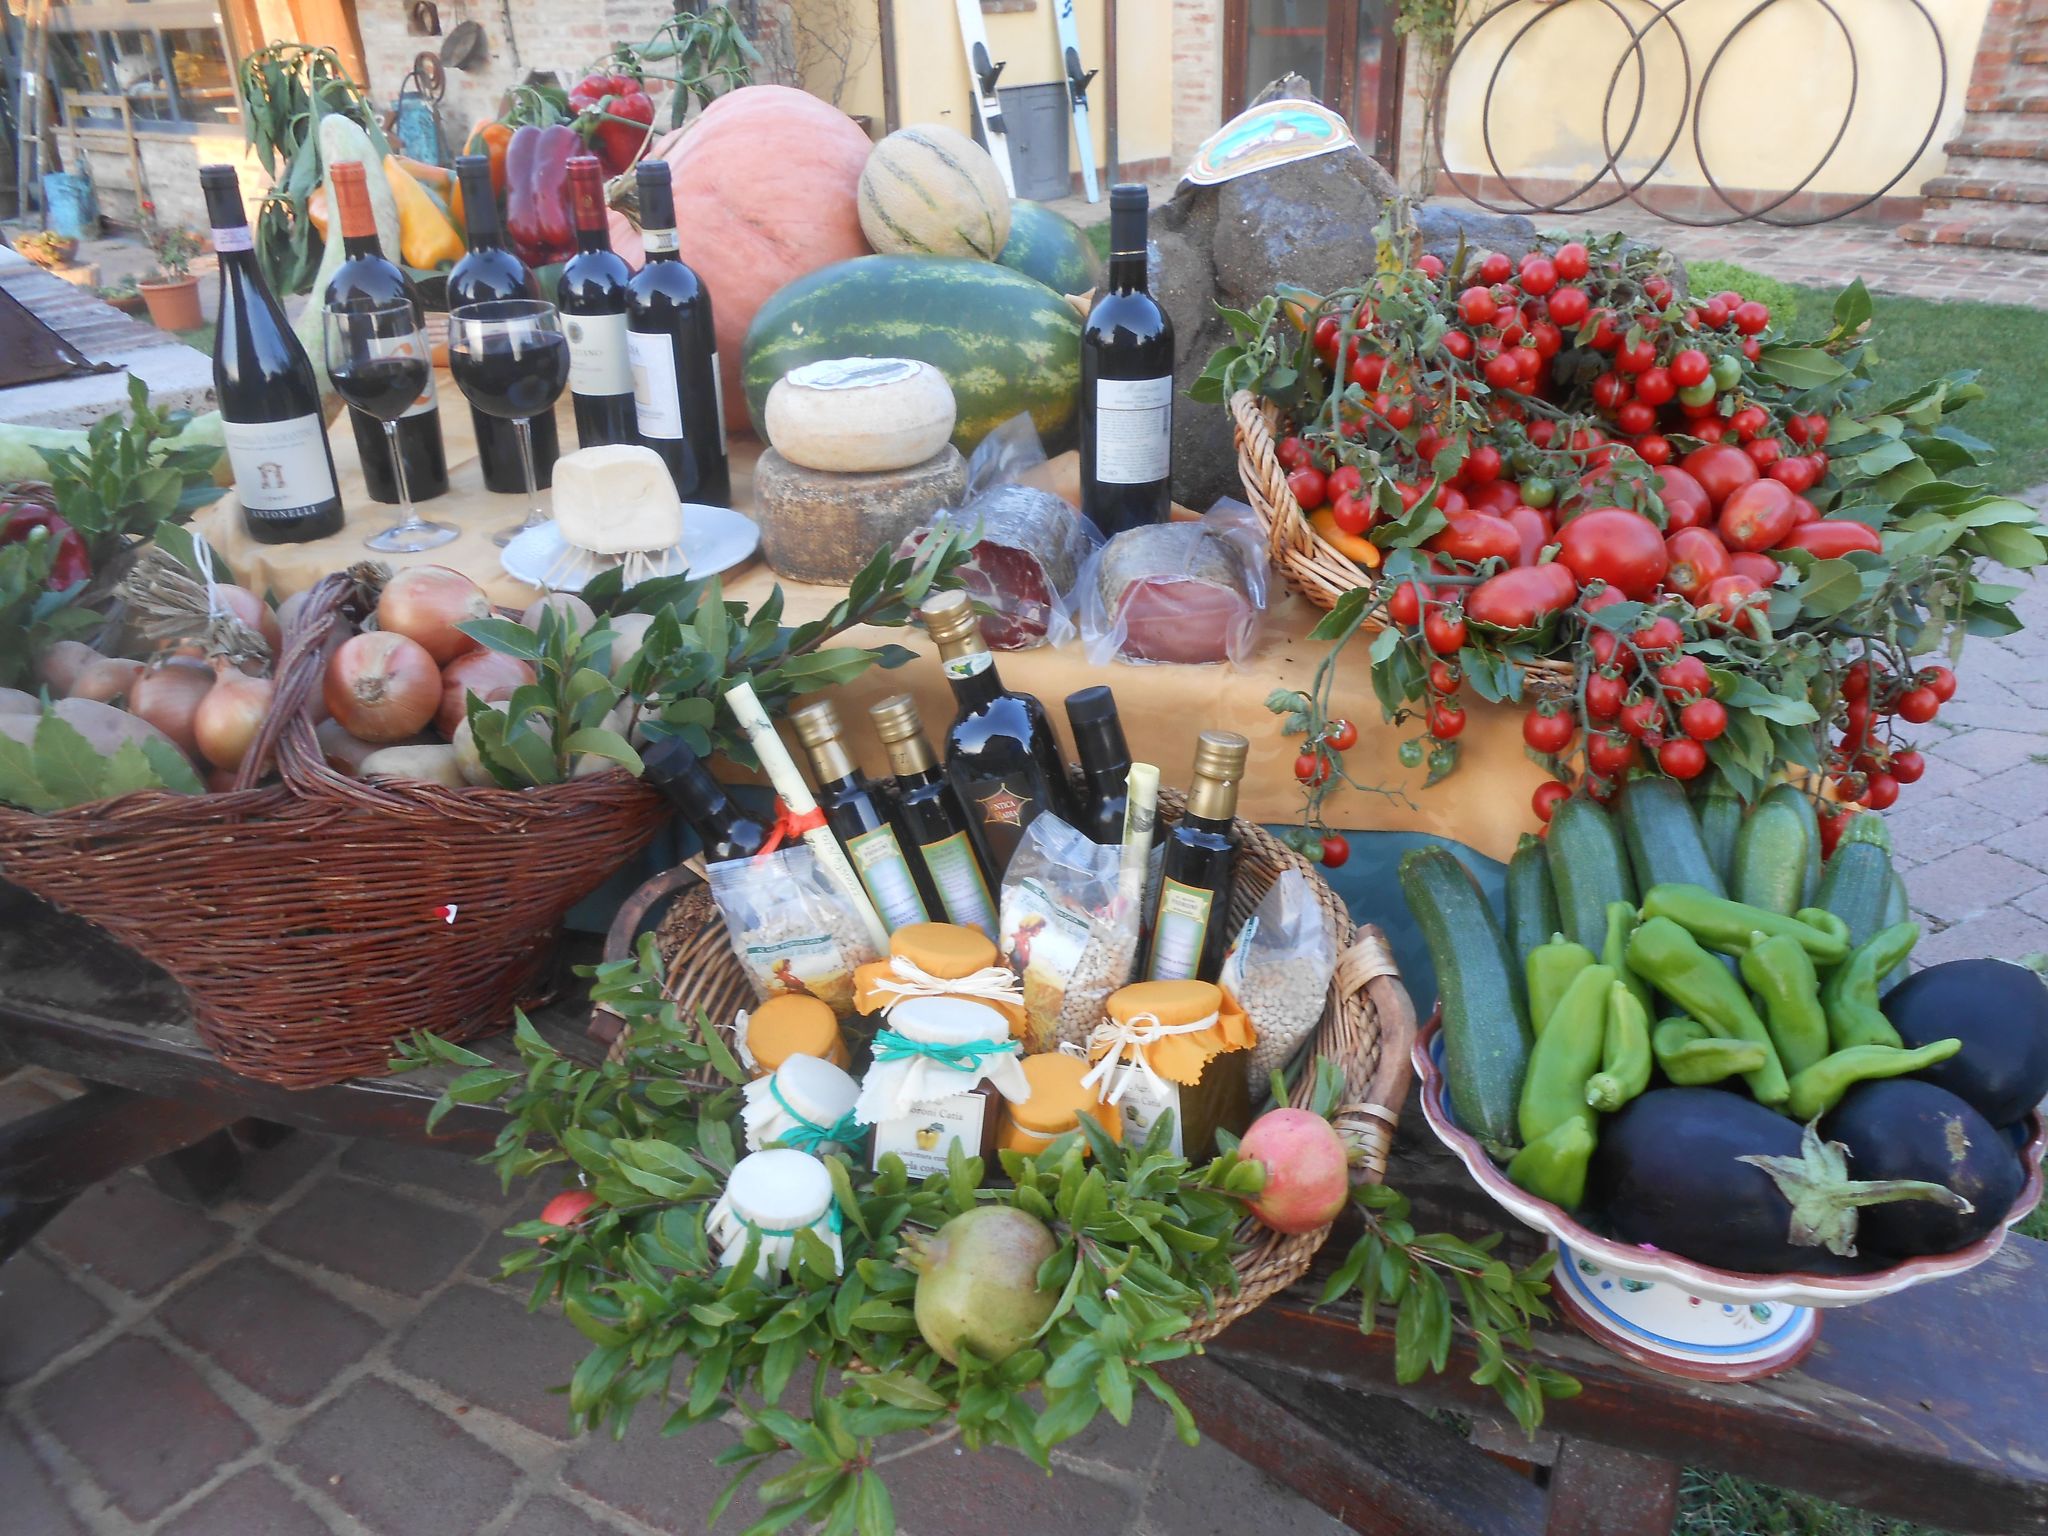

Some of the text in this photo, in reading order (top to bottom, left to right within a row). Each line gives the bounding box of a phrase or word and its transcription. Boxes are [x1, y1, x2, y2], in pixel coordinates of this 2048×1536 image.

[250, 505, 318, 520] ANTONELLI
[910, 1106, 963, 1121] oroni Catia
